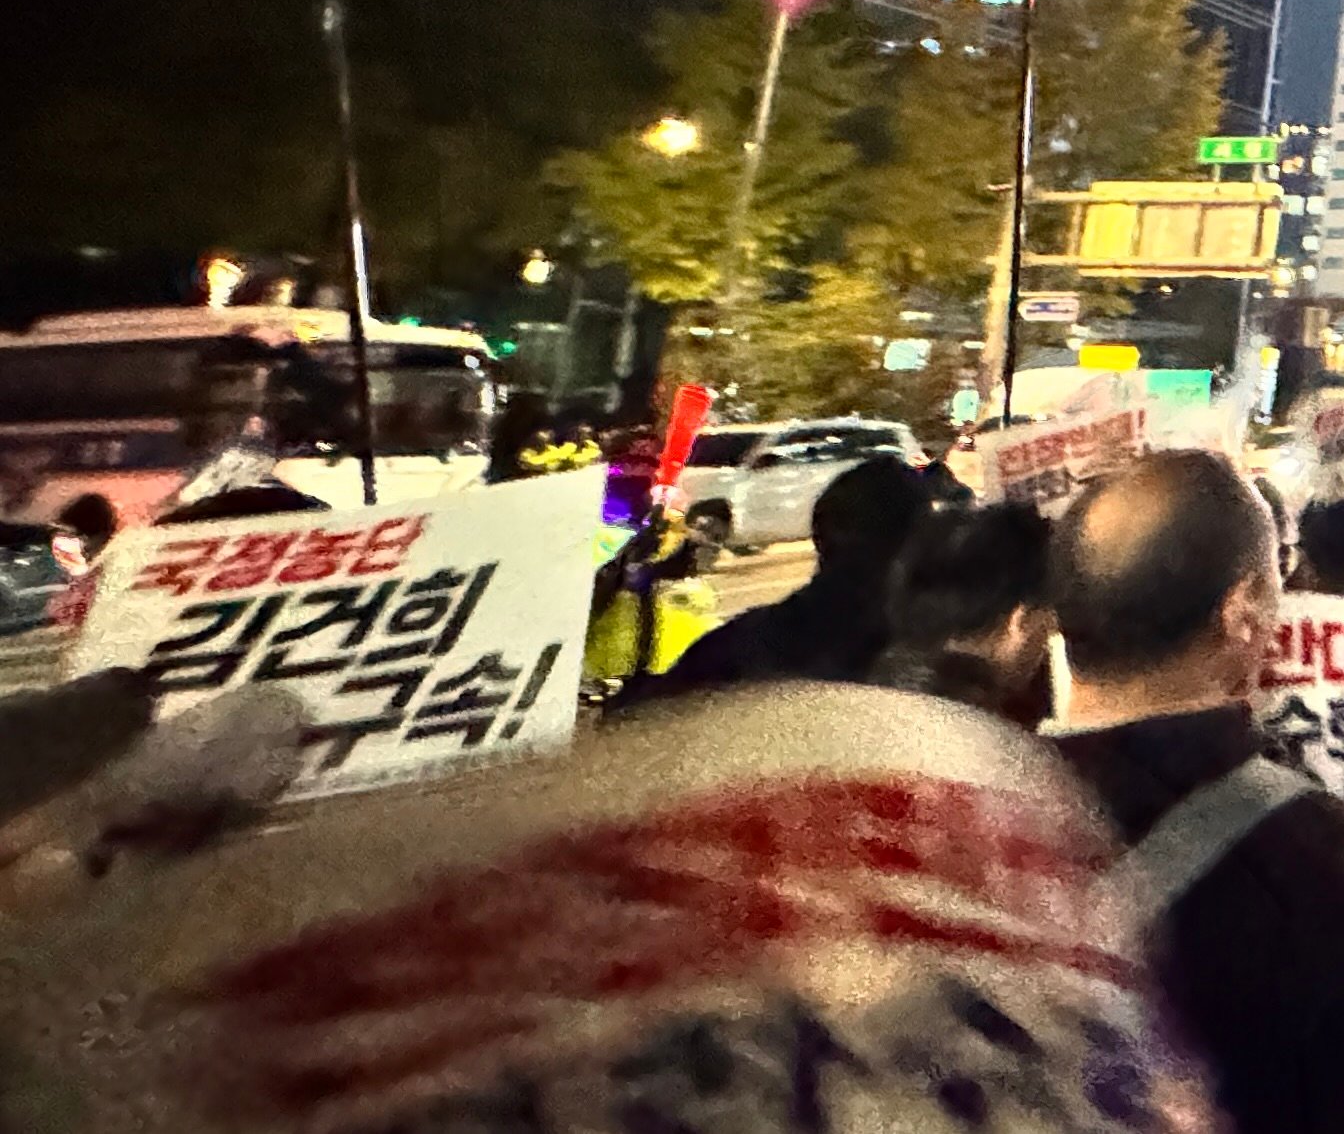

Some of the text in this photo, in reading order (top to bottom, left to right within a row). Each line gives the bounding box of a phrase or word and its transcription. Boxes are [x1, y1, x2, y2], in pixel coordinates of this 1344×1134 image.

[131, 511, 432, 596] 국정농단
[146, 560, 500, 692] 김건희
[300, 641, 563, 771] 구속!
